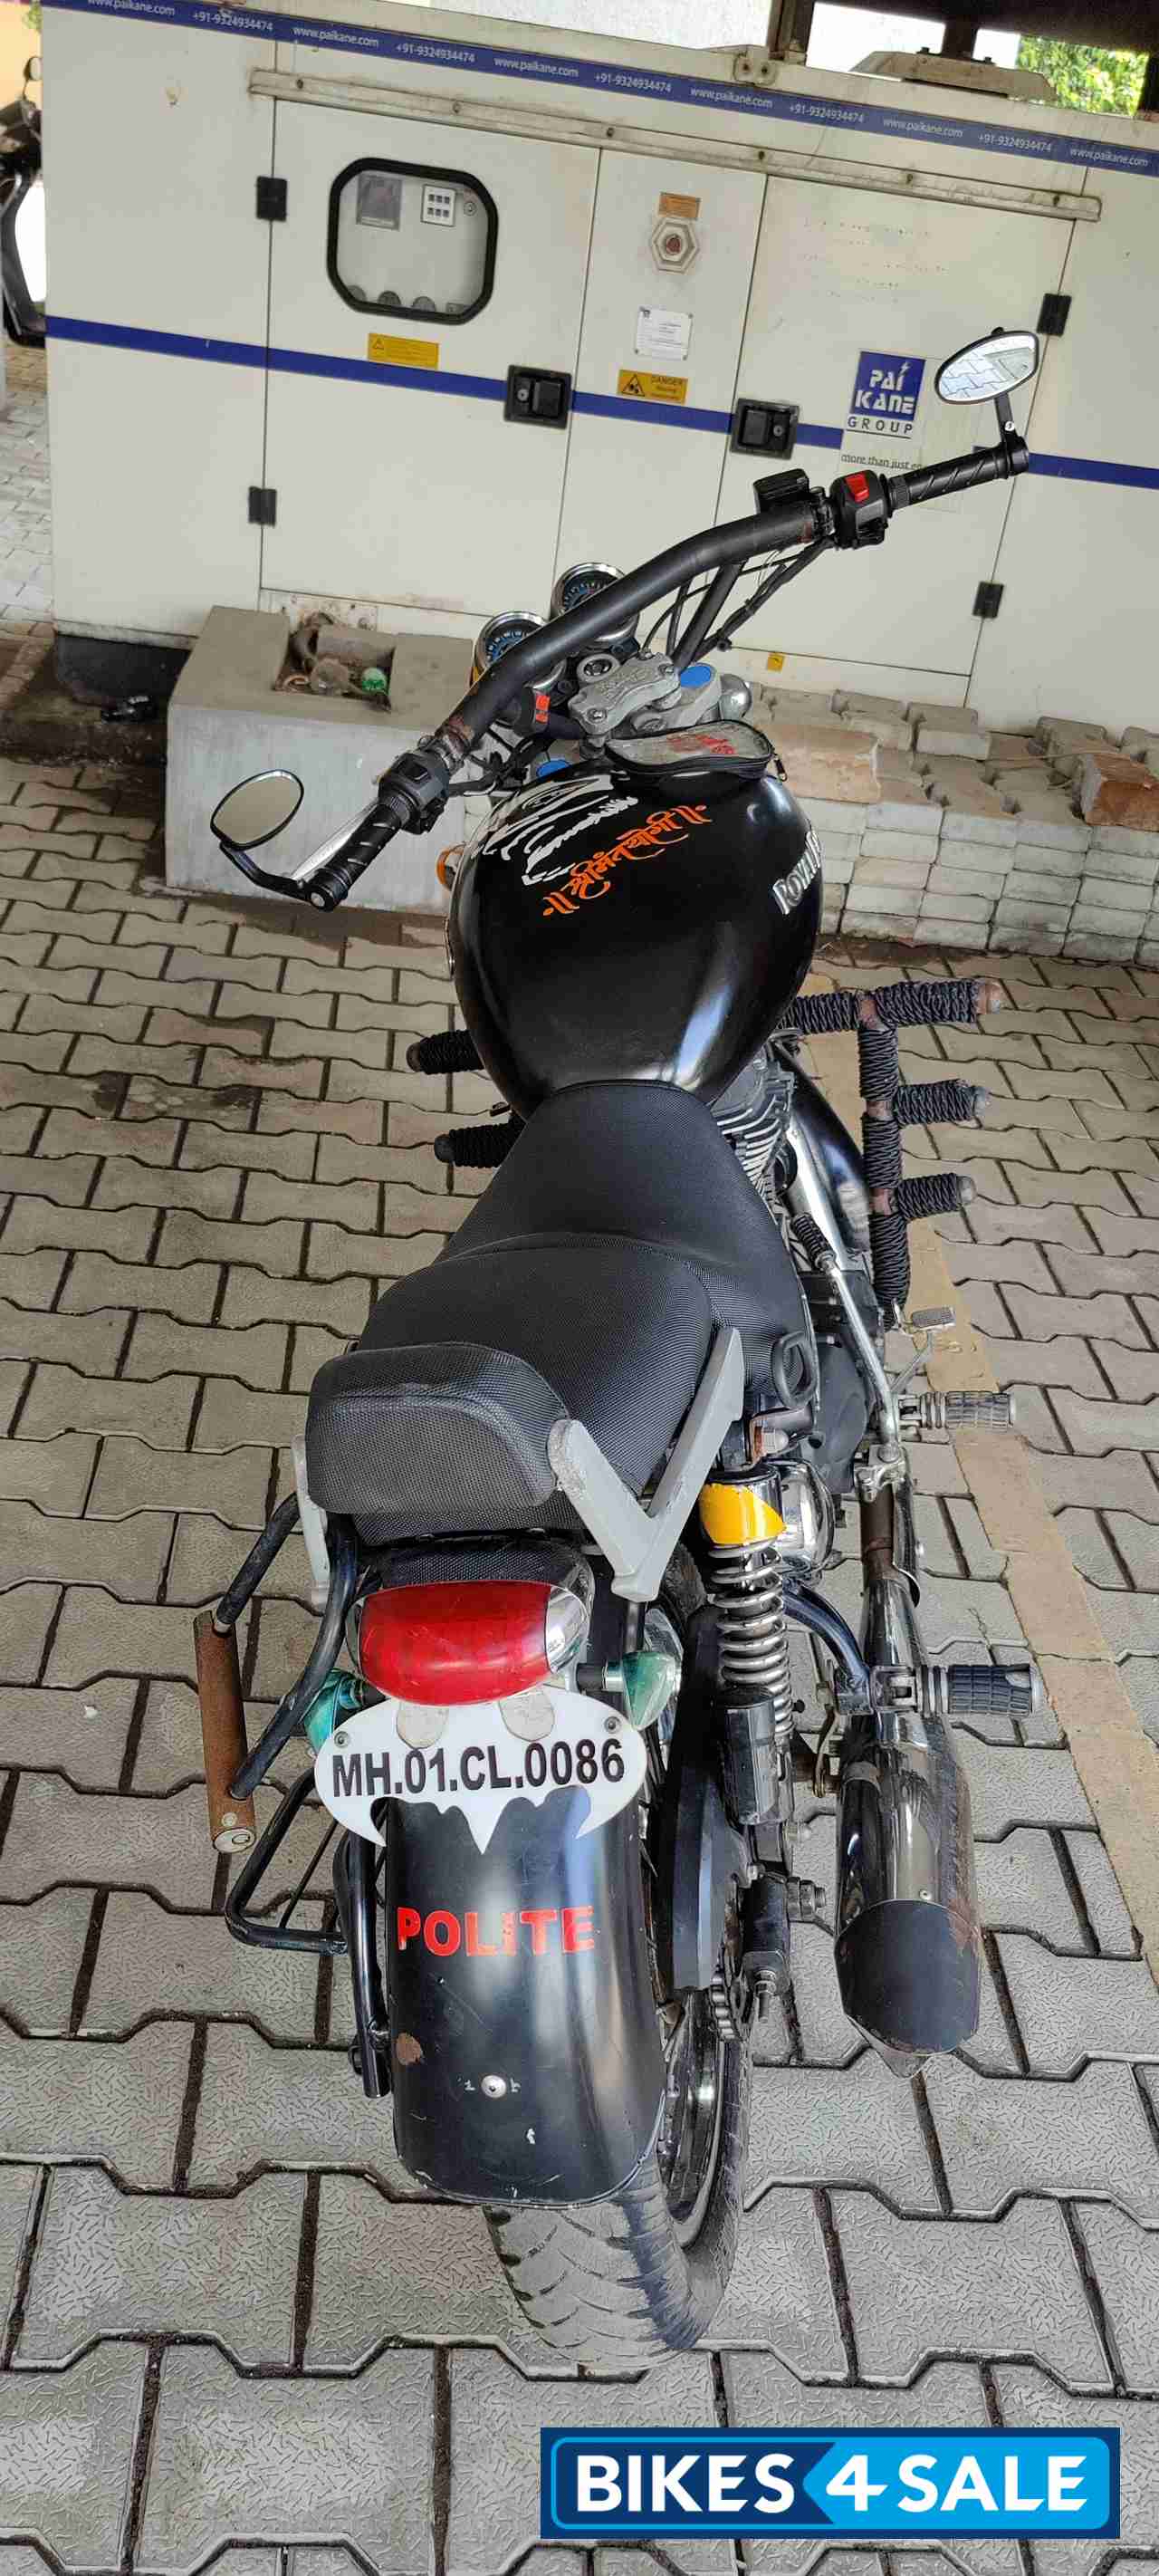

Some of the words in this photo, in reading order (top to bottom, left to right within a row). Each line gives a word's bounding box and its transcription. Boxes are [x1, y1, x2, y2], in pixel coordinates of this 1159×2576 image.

[292, 26, 378, 48] www.paikane.com
[396, 42, 475, 63] +91-9324934474
[493, 56, 579, 78] www.paikane.com
[595, 72, 672, 93] +91-9324934474
[690, 88, 772, 109] www.paikane.com
[789, 102, 864, 123] +91-9324934474
[883, 117, 963, 138] www.paikane.com
[978, 132, 1052, 153] +91-9324934474
[1069, 146, 1148, 167] www.paikane.com
[855, 389, 915, 414] KANE
[848, 416, 913, 434] GROUP
[840, 454, 867, 464] more
[867, 456, 889, 467] than
[890, 459, 910, 469] just
[332, 1738, 626, 1798] MH.01.CL.0086
[397, 1906, 595, 1956] POLITE
